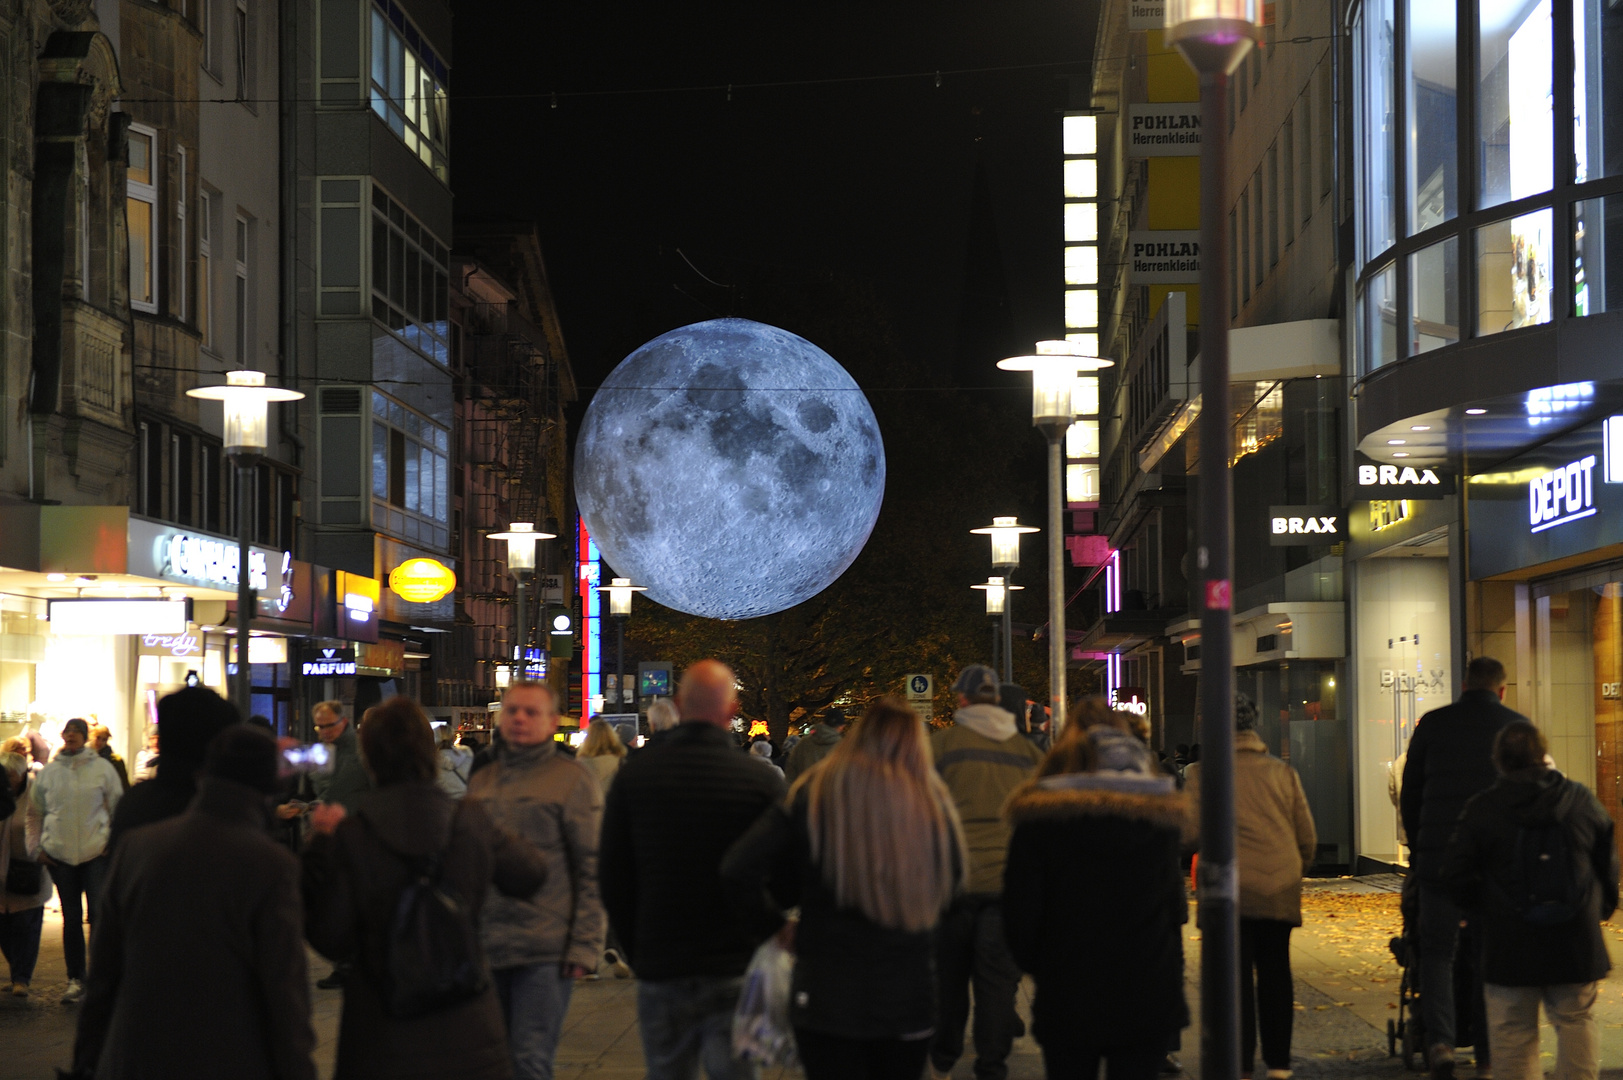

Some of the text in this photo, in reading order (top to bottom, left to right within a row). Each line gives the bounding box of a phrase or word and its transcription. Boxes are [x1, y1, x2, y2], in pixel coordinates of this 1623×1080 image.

[1358, 464, 1440, 485] BRAX
[1529, 454, 1596, 526] DEPOT
[1271, 516, 1338, 534] BRAX
[141, 631, 200, 657] tredy
[302, 662, 357, 676] PARFUM
[1380, 669, 1444, 688] BRAX
